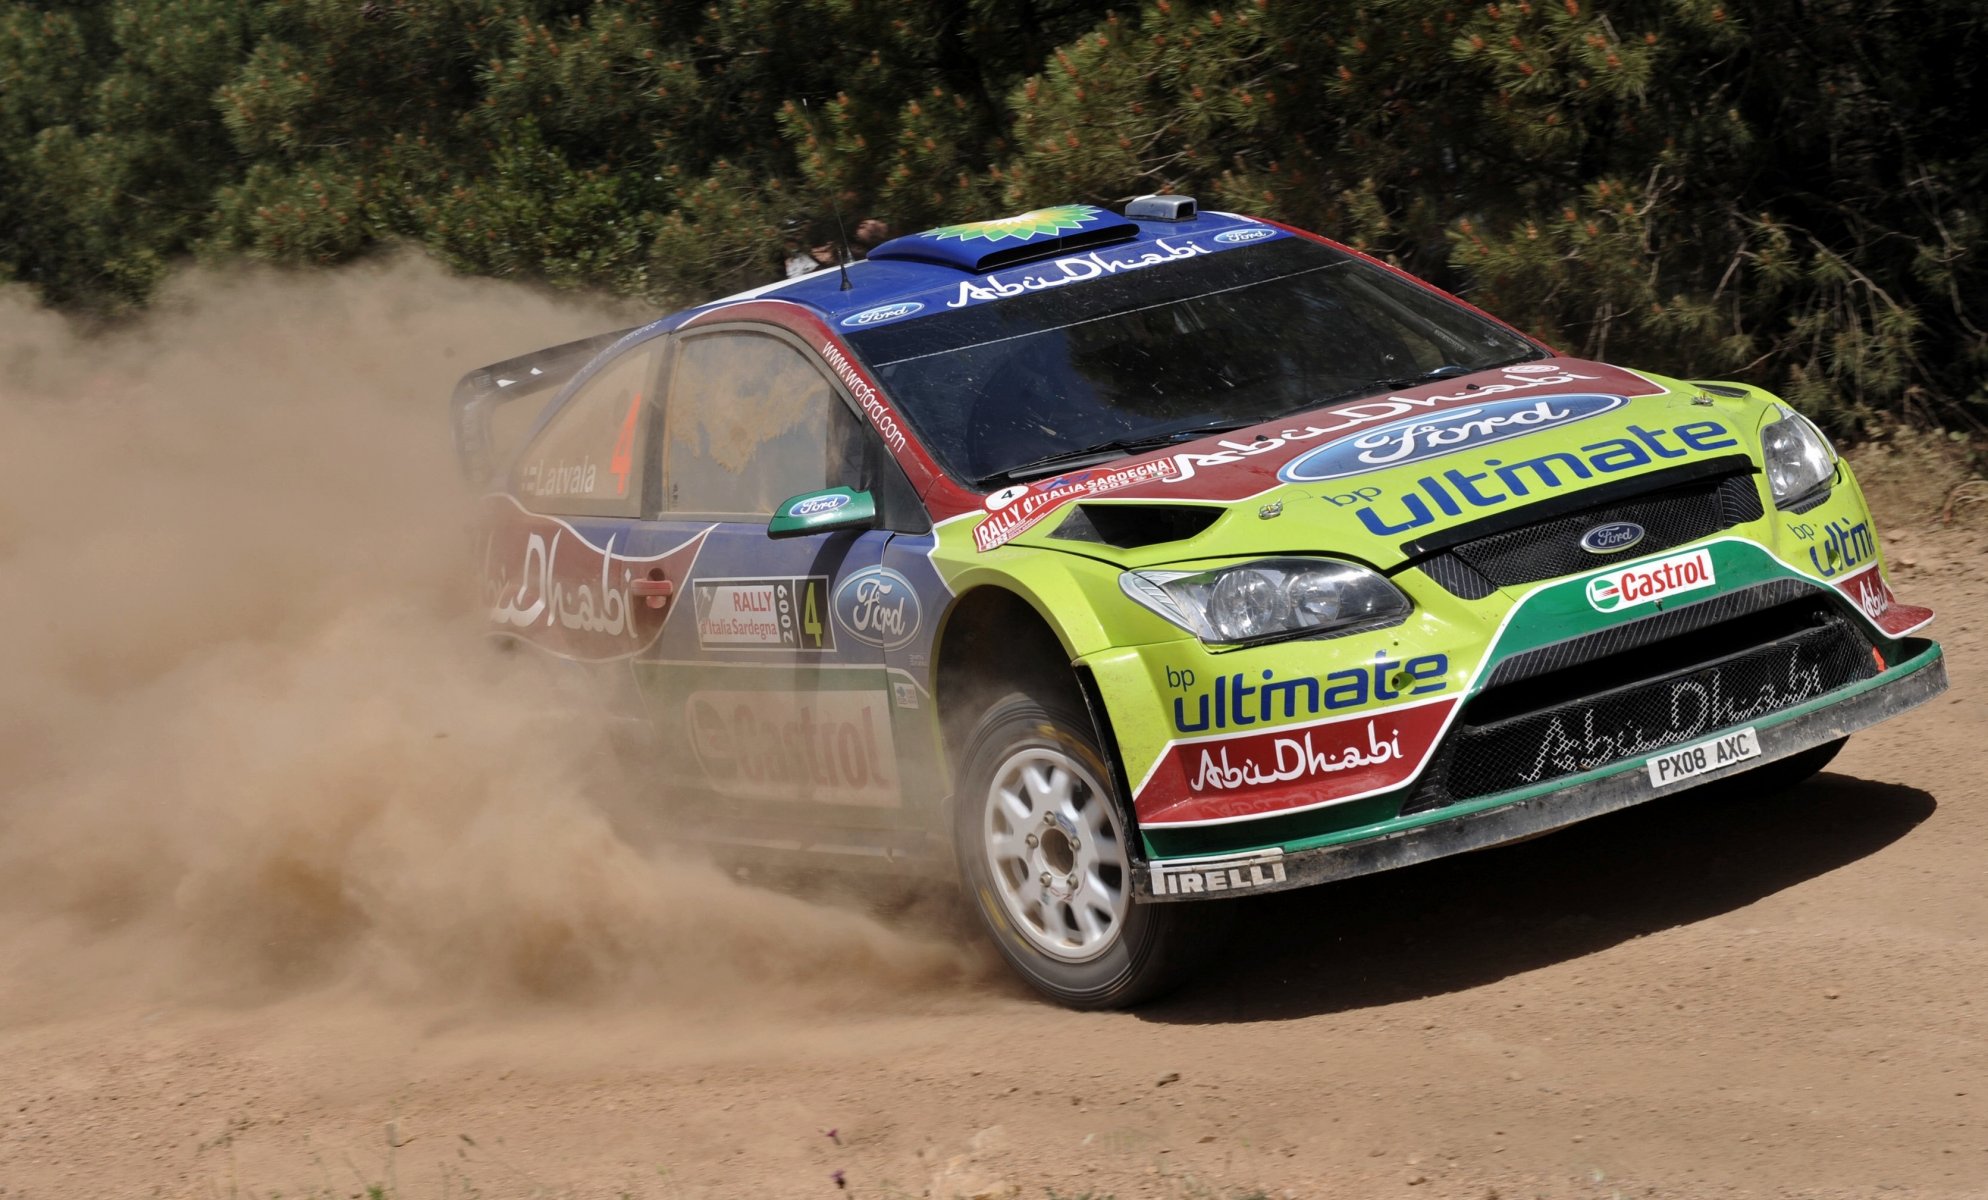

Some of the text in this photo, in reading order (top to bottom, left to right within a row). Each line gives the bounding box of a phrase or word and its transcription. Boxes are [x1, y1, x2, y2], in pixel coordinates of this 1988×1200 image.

[1226, 229, 1267, 241] Ford
[858, 306, 908, 324] Ford
[822, 341, 906, 453] www.wrcford.com
[610, 393, 641, 496] 4
[1354, 401, 1571, 464] Ford
[536, 456, 596, 496] Latvala
[1001, 490, 1014, 500] 4
[1322, 486, 1382, 507] bp
[1355, 420, 1738, 536] ultimate
[800, 497, 839, 514] Ford
[979, 506, 1022, 545] RALLY
[1598, 527, 1632, 546] Ford
[1787, 523, 1814, 540] bp
[1621, 555, 1708, 601] Castrol
[733, 591, 772, 612] RALLY
[777, 584, 794, 643] 2009
[804, 582, 822, 647] 4
[853, 579, 907, 636] Ford
[733, 618, 777, 640] Sardegna
[1166, 666, 1194, 691] bp
[1174, 650, 1448, 733] ultimate
[734, 704, 891, 790] Castrol
[1658, 733, 1750, 780] PX08 AXC
[1150, 848, 1287, 895] PIRELLI
